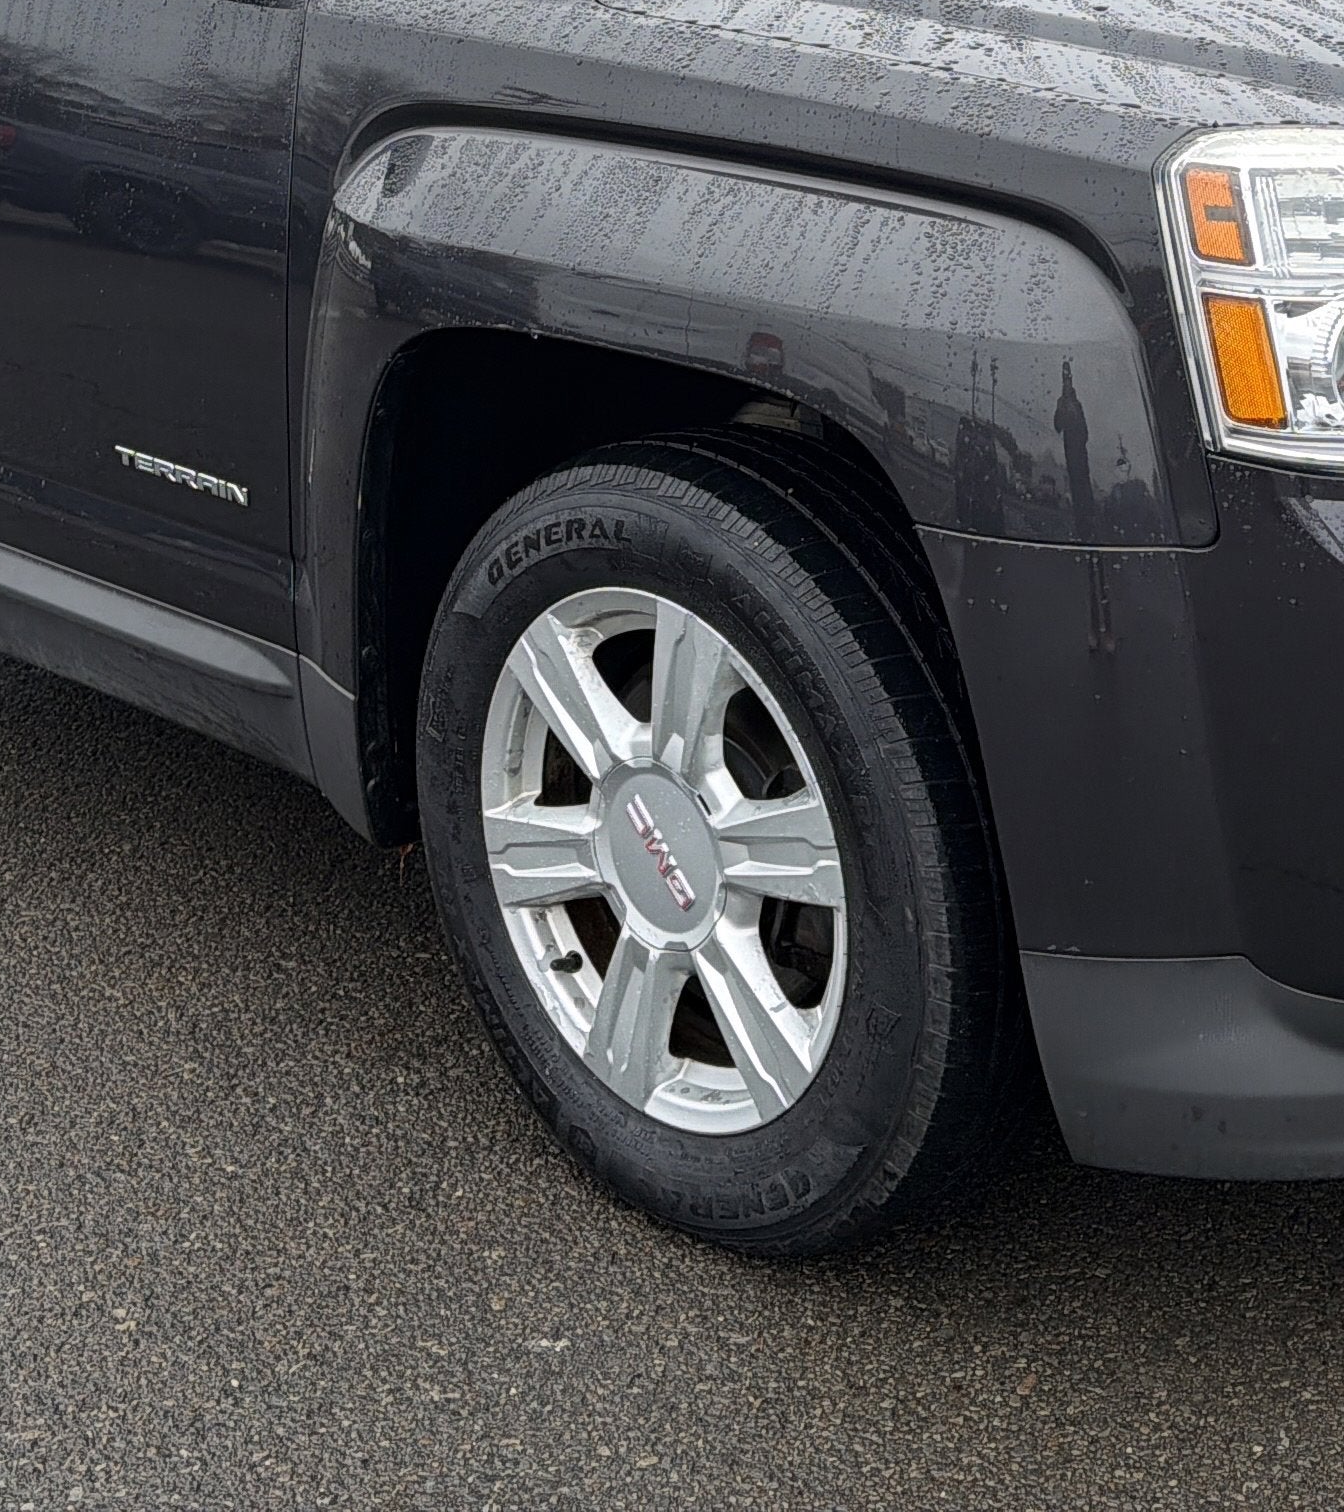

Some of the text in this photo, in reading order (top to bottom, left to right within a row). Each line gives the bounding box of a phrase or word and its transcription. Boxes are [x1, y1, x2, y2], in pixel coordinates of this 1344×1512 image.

[114, 444, 249, 507] TERRAIN
[487, 517, 633, 586] GENERAL
[626, 793, 696, 912] GMC
